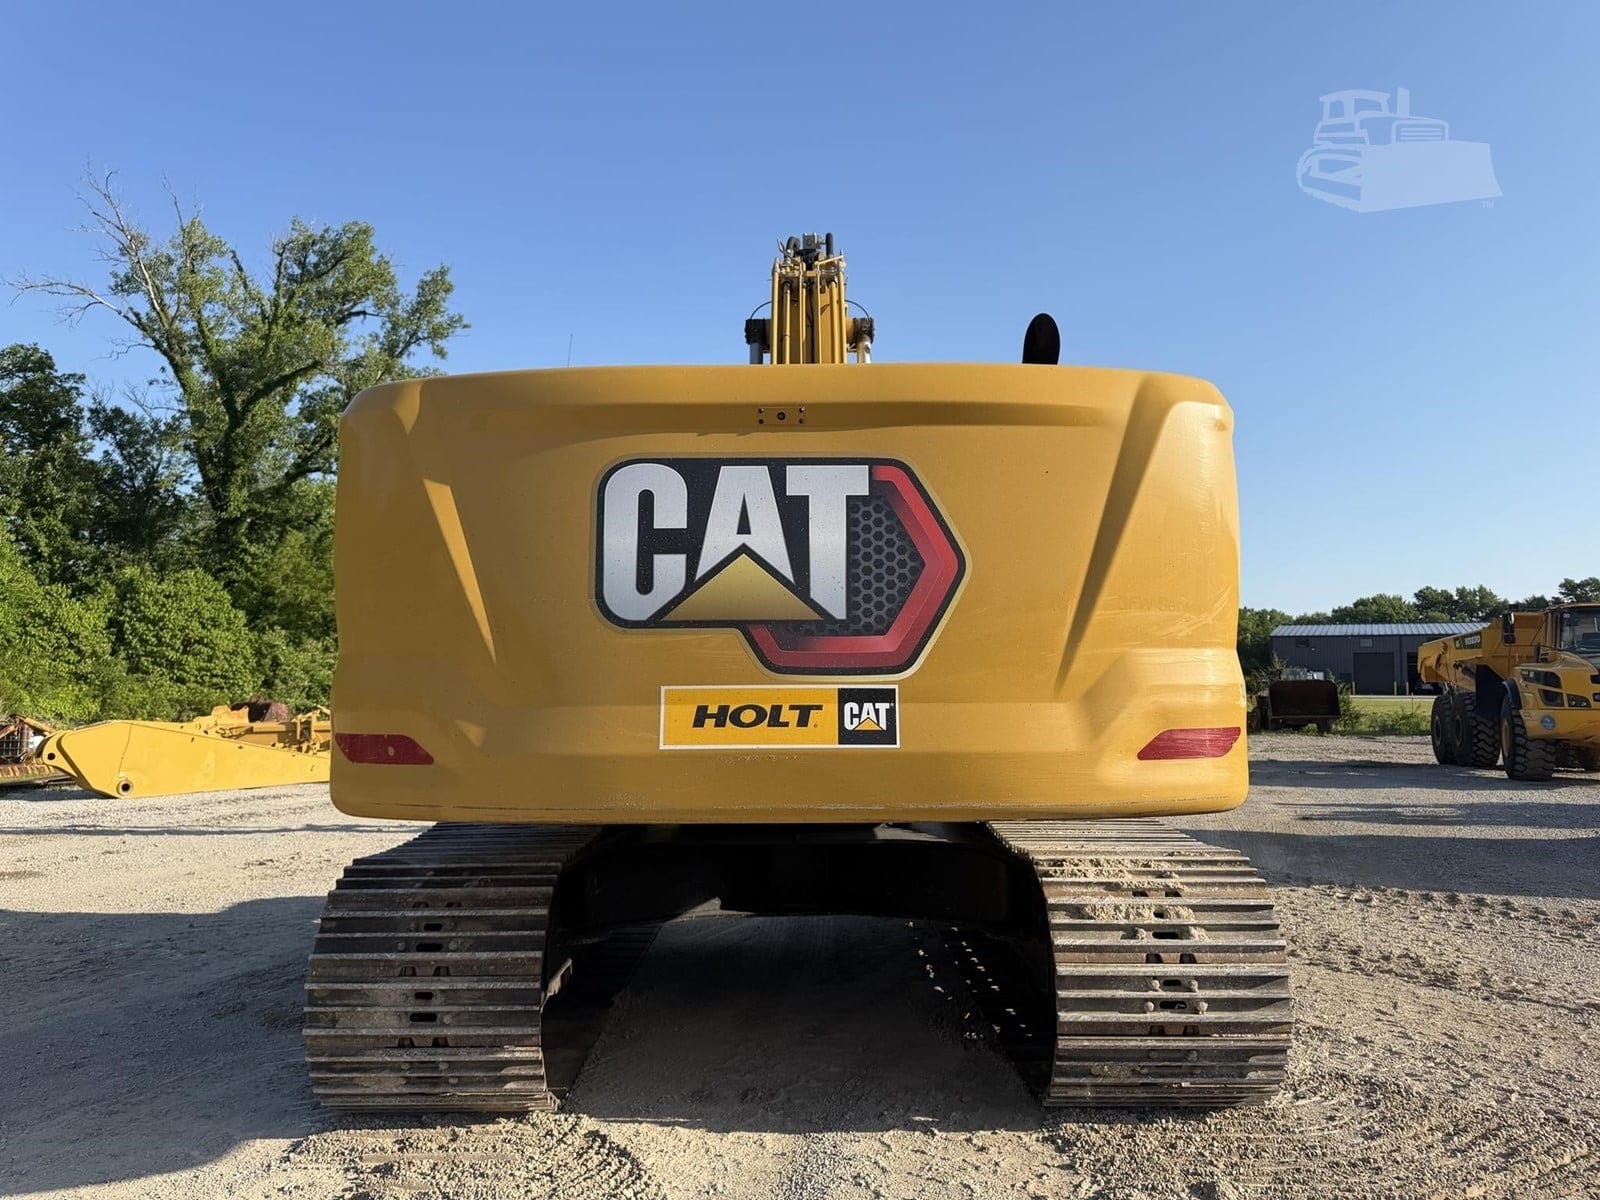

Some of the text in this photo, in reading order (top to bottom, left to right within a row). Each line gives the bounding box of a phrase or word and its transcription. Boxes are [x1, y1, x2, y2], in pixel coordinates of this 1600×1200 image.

[603, 463, 869, 621] CAT
[692, 702, 890, 730] HOLT CAT
